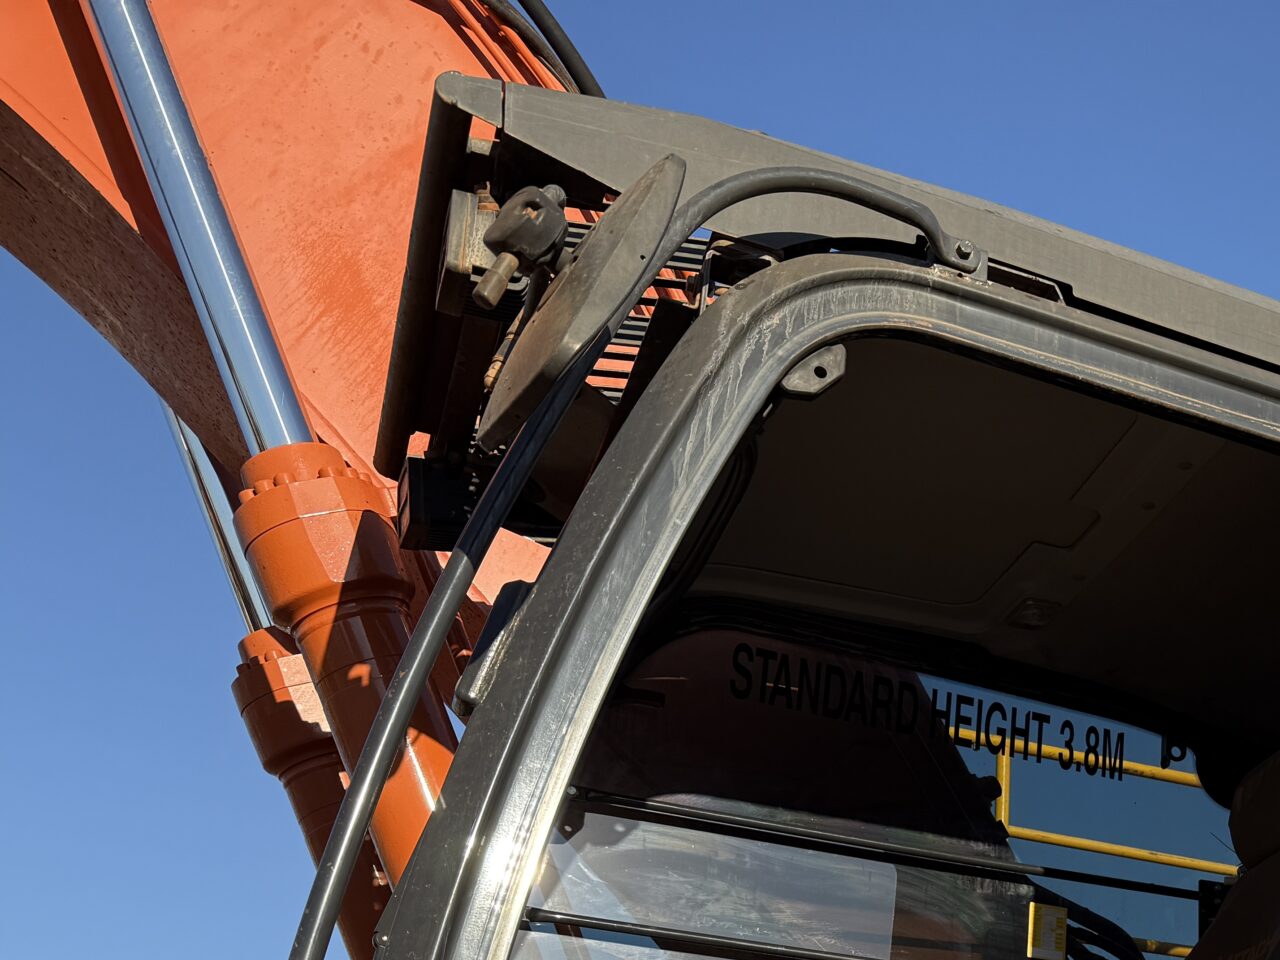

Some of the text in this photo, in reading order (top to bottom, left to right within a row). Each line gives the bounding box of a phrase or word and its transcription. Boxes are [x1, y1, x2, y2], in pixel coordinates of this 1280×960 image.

[730, 643, 1125, 781] STANDARD HEIGHT 3.8M
